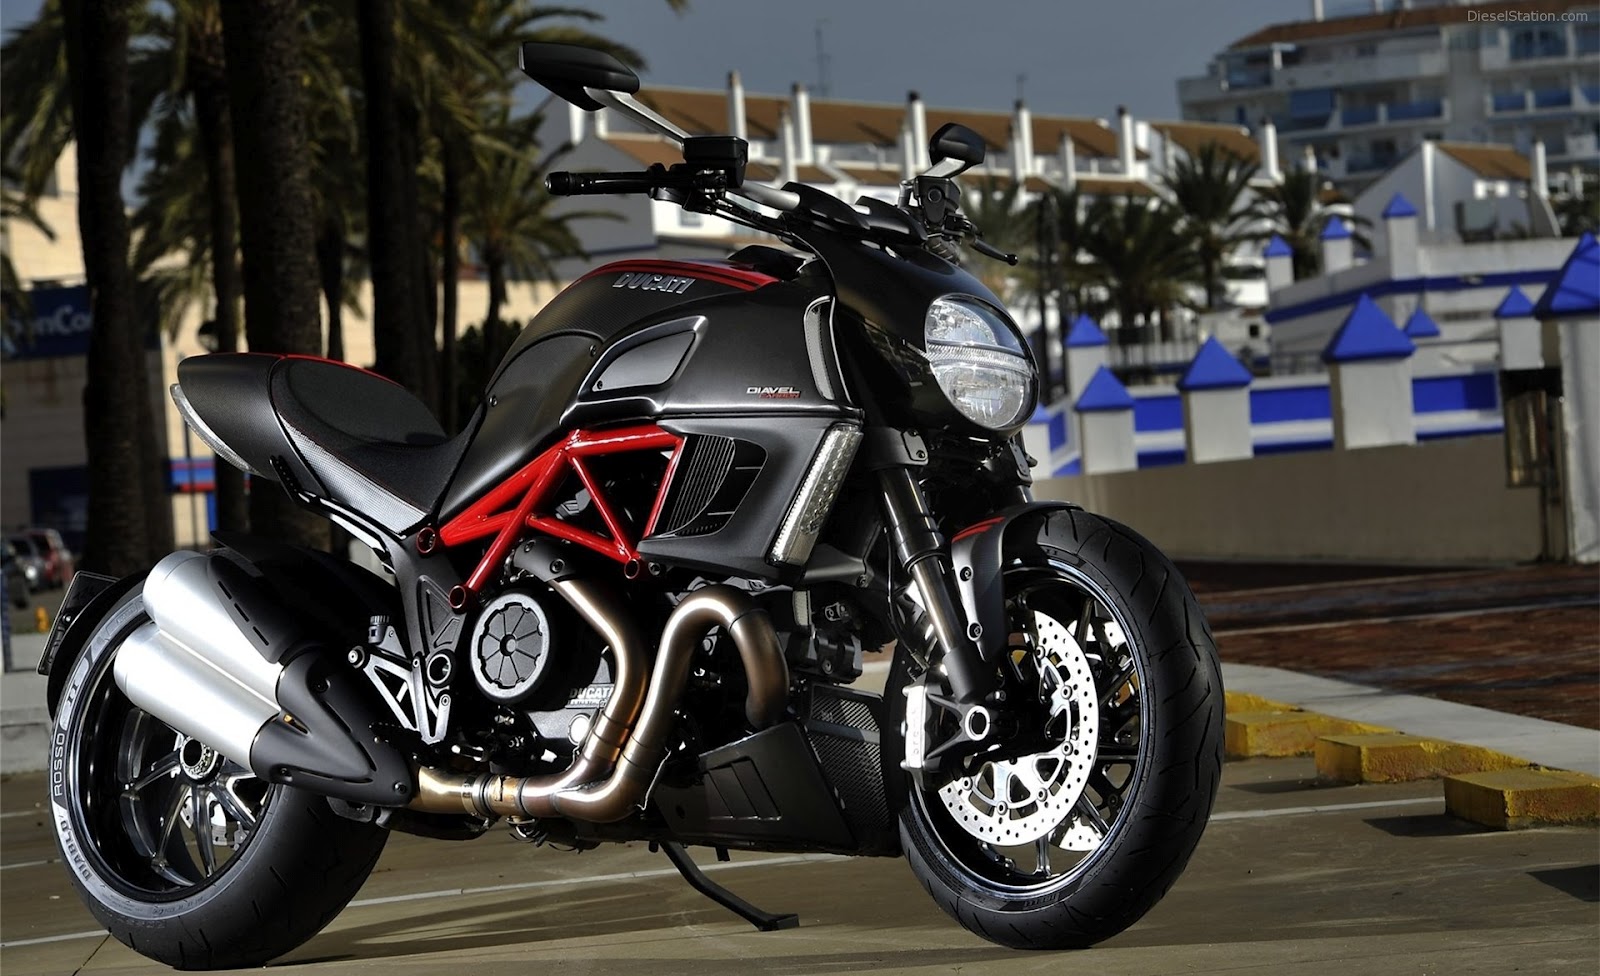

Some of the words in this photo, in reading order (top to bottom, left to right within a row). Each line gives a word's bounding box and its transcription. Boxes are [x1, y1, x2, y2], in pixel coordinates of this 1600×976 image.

[612, 272, 697, 295] DUCATI
[746, 386, 801, 394] DIAVEL
[53, 732, 66, 797] ROSSO
